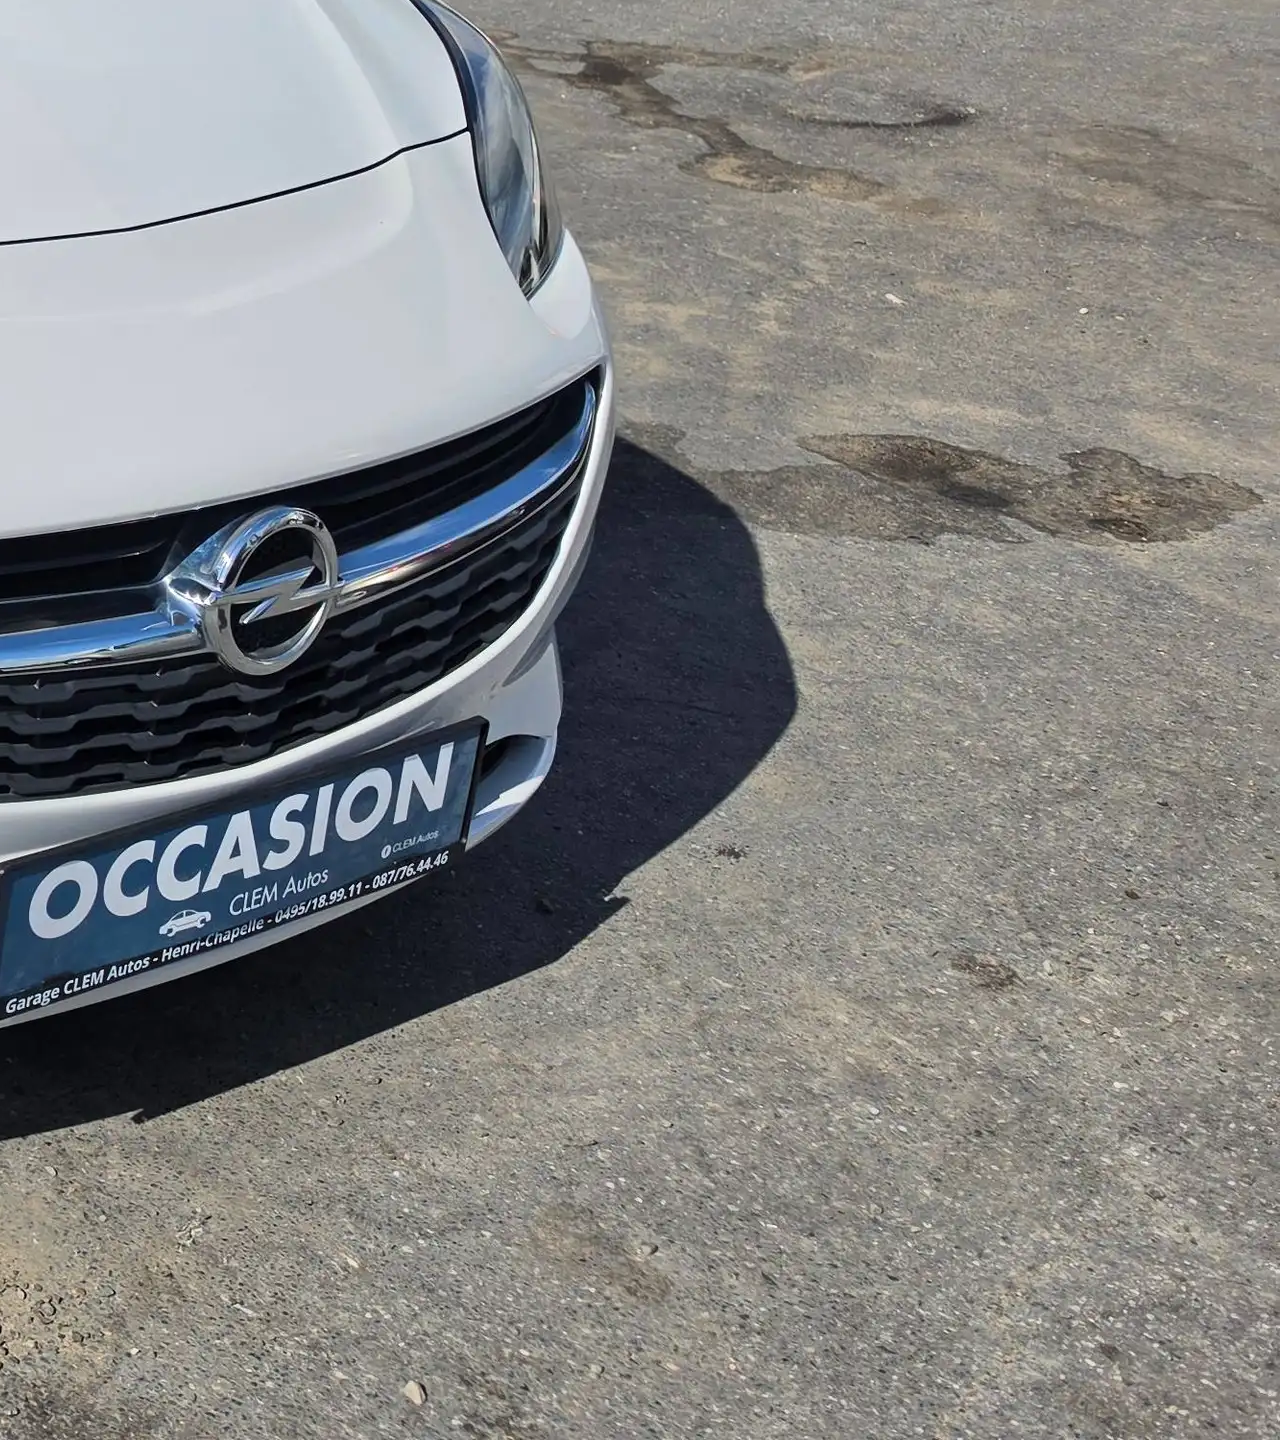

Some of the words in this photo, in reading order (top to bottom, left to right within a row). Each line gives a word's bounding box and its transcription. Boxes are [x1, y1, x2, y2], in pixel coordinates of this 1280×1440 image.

[28, 741, 455, 940] OCCASION
[229, 881, 278, 916] CLEM
[282, 868, 329, 898] Autos
[392, 836, 416, 853] CLEM
[416, 830, 439, 844] Autos
[5, 987, 60, 1015] Garage
[63, 969, 105, 995] CLEM
[107, 956, 150, 980] Autos
[161, 917, 264, 962] Henri-Chapelle
[274, 881, 362, 924] 0495/18.99.11
[372, 850, 449, 890] 087/76.44.46
